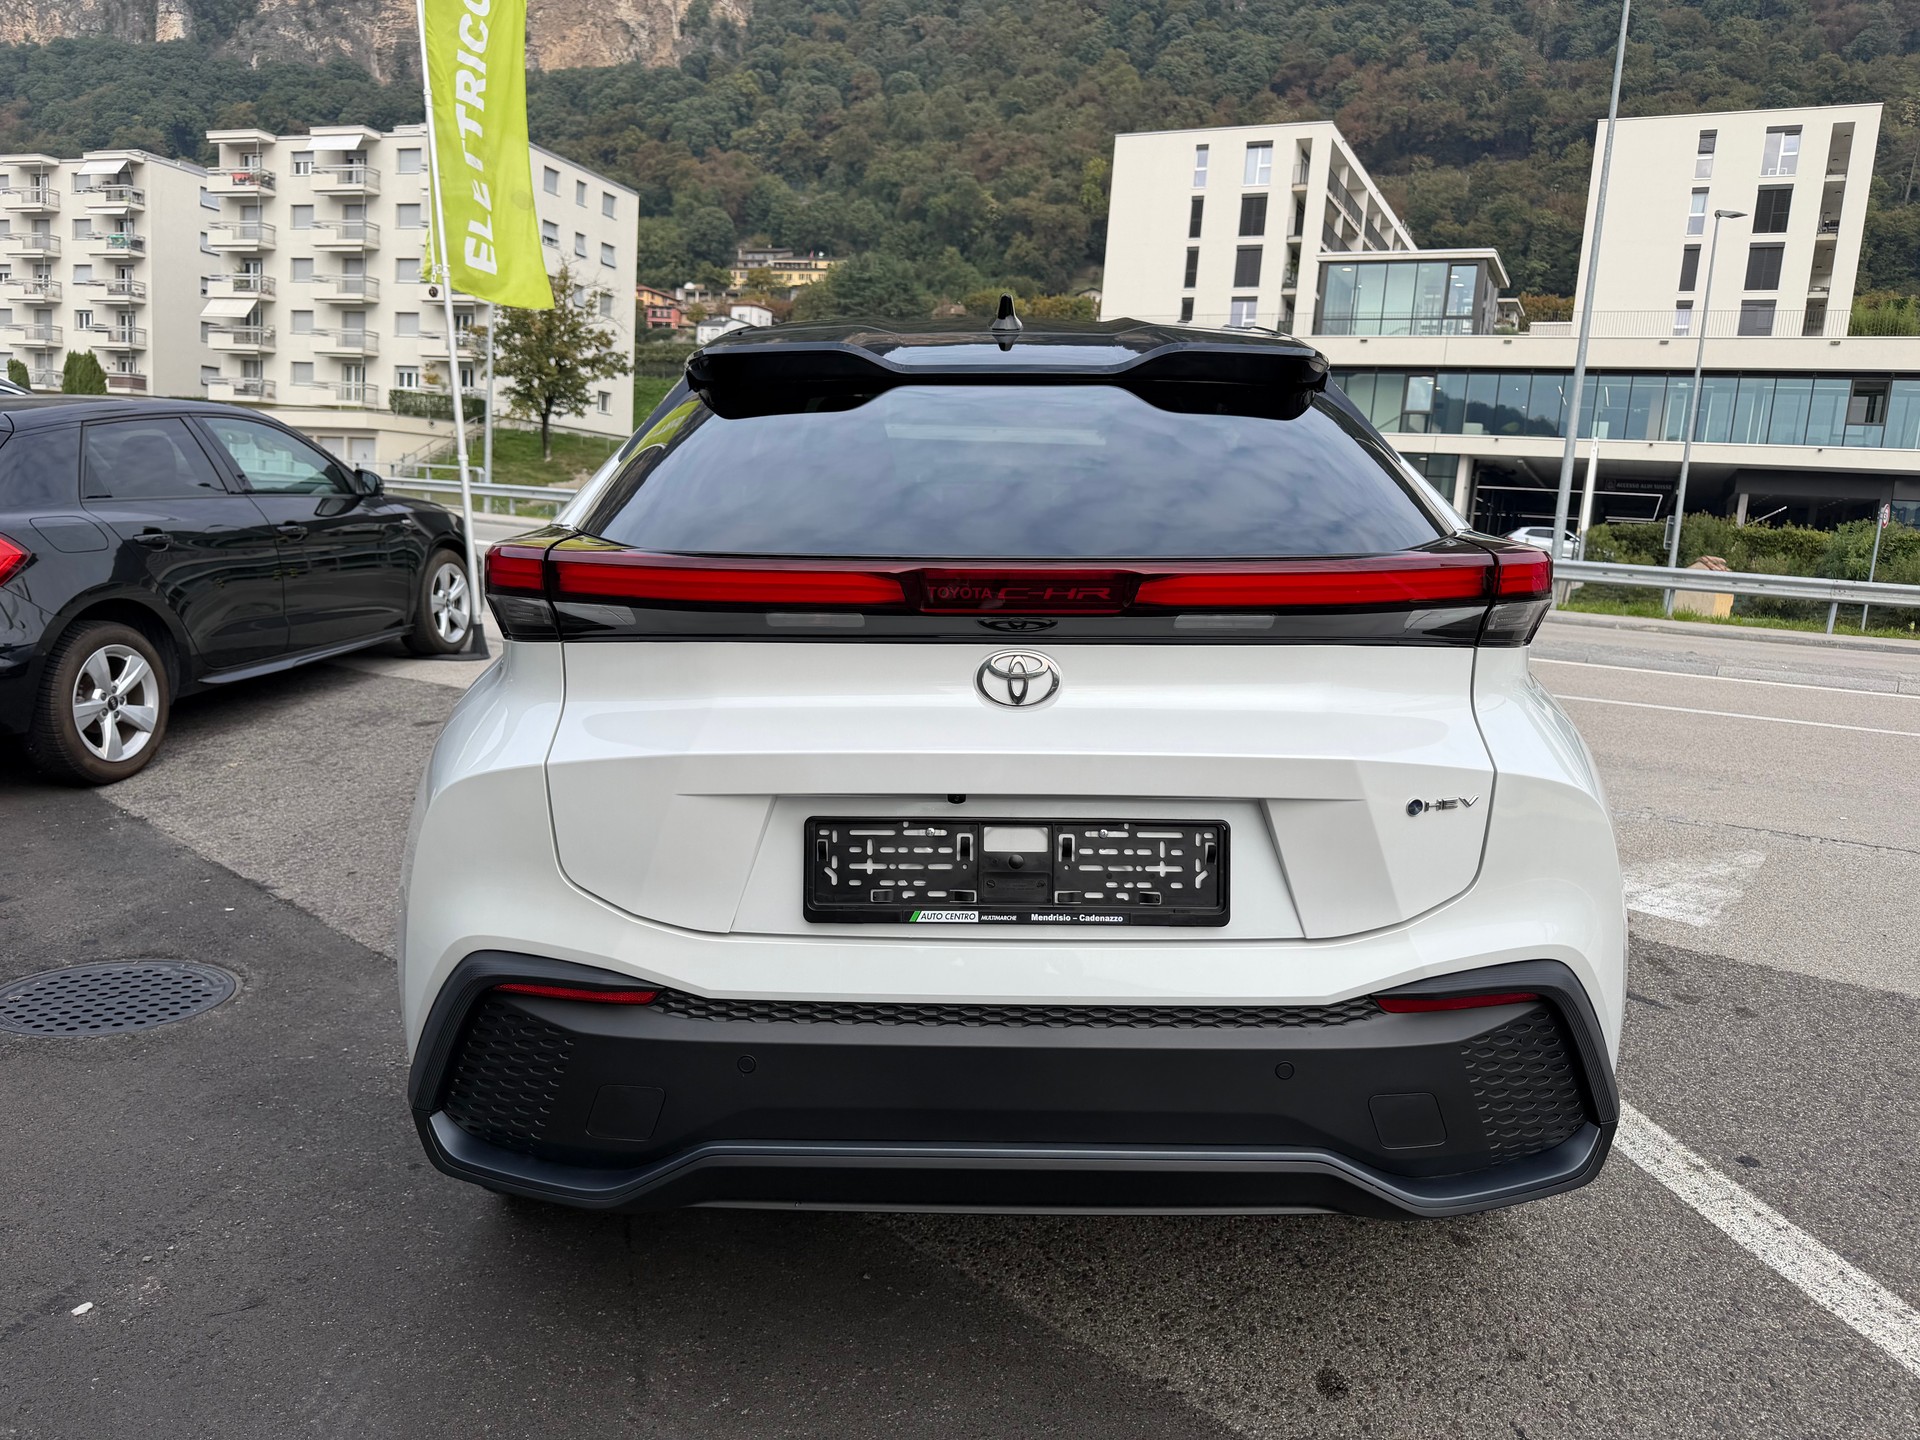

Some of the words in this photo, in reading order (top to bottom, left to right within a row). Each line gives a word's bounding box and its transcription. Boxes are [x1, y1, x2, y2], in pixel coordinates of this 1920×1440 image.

[928, 586, 993, 599] TOYOTA
[997, 587, 1111, 600] C-HR
[921, 912, 943, 920] AUTO
[945, 912, 976, 920] CENTRO
[1031, 913, 1071, 921] Mendrisio
[1079, 914, 1124, 922] Cadenazzo
